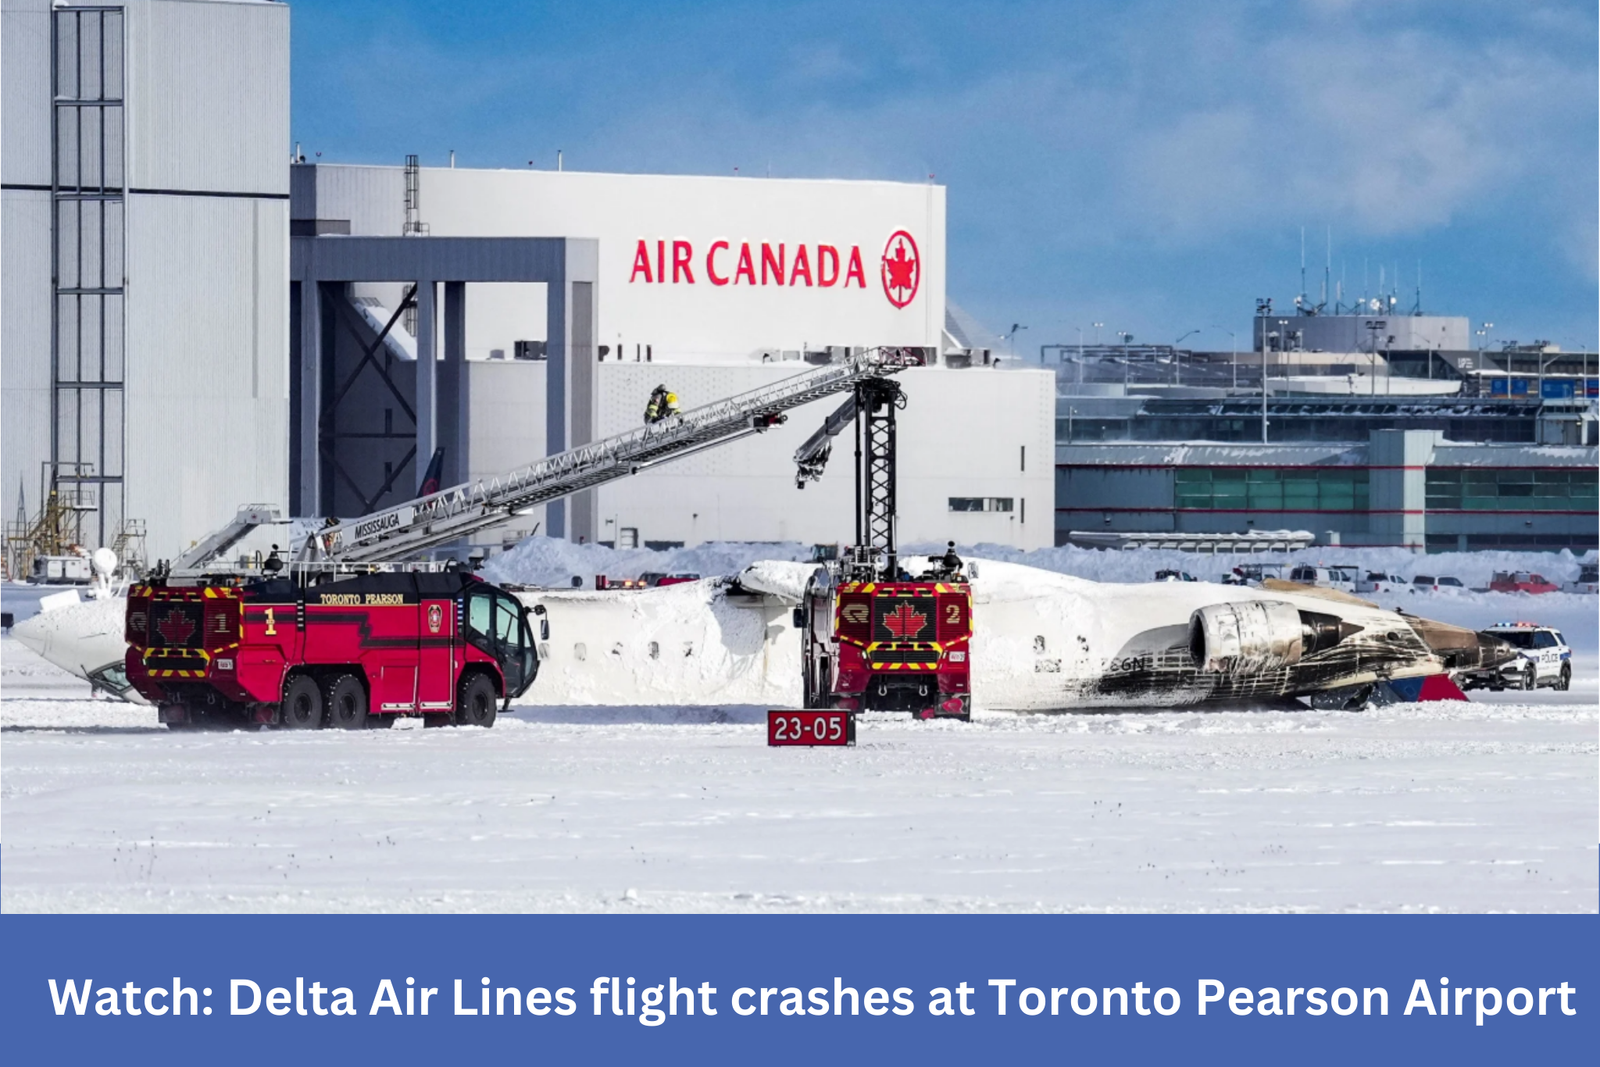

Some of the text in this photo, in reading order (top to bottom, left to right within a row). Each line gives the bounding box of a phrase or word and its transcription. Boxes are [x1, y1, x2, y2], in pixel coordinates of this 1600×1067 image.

[629, 239, 867, 289] AIR CANADA
[354, 512, 400, 540] MISSISSAUGA
[320, 593, 404, 605] TORONTO PEARSON
[214, 613, 231, 633] 1
[264, 607, 277, 635] 1
[945, 604, 960, 624] 2
[1541, 653, 1559, 664] POLICE
[775, 716, 842, 740] 23-05
